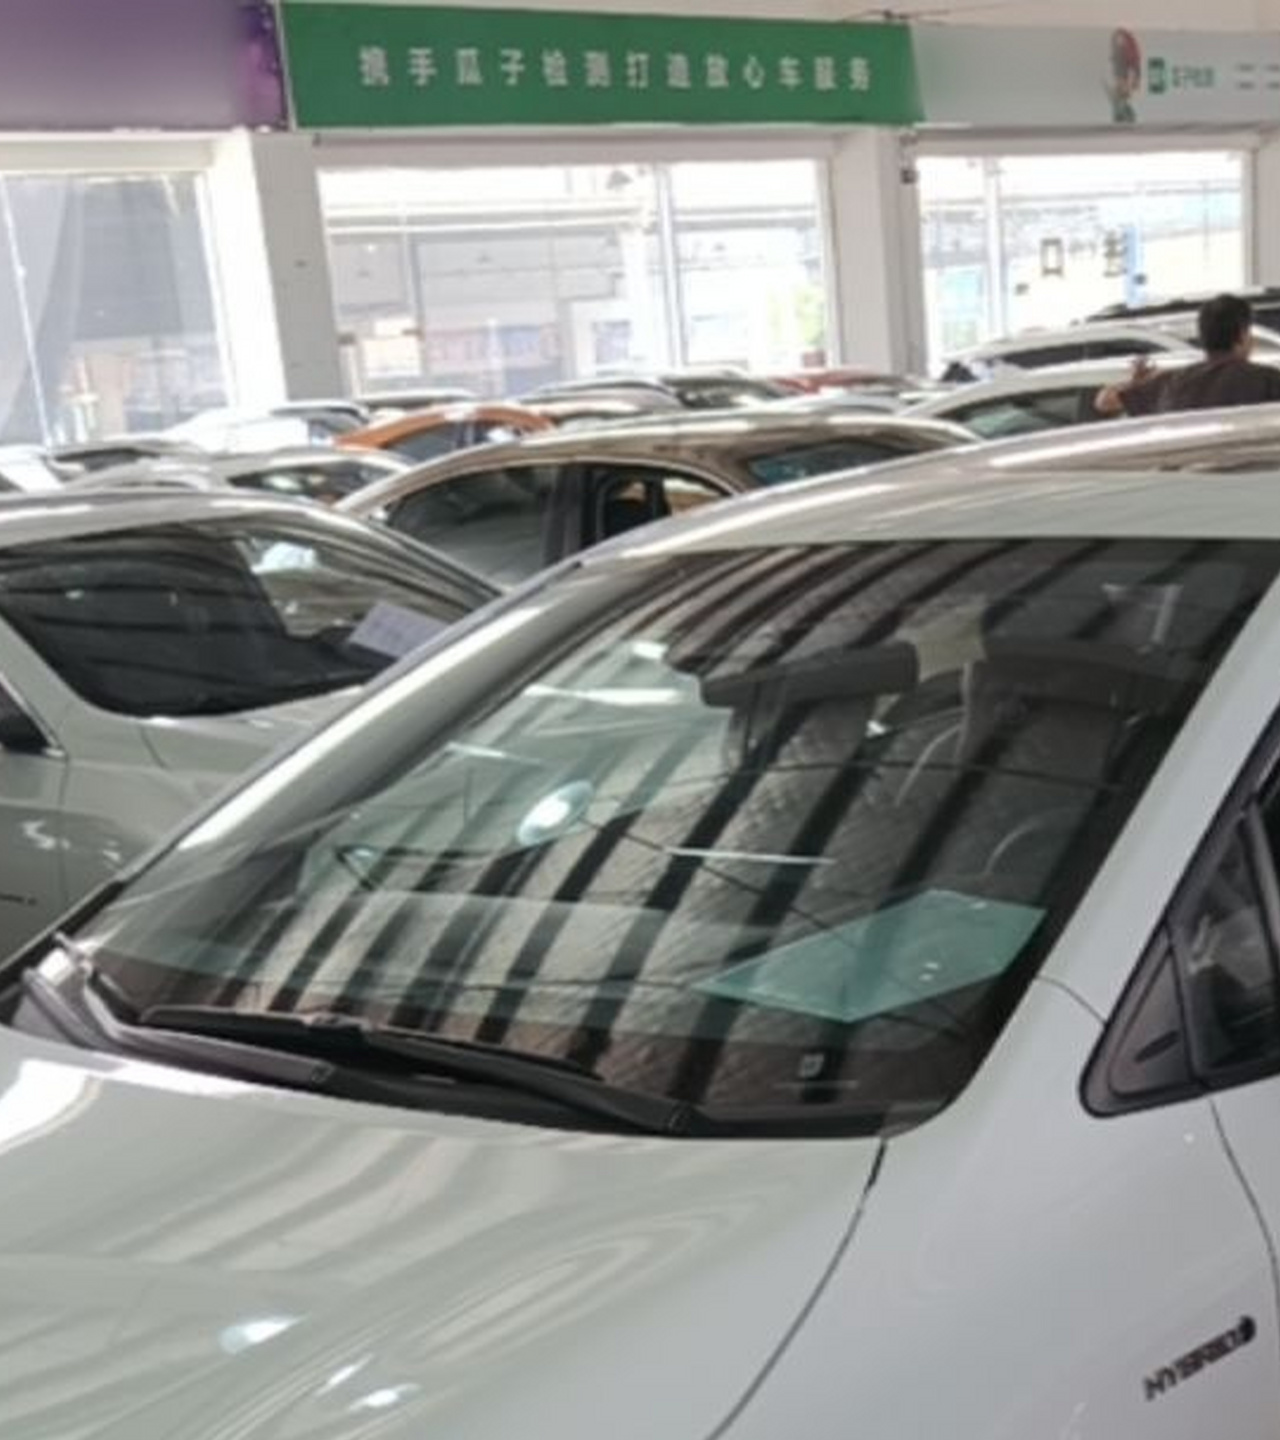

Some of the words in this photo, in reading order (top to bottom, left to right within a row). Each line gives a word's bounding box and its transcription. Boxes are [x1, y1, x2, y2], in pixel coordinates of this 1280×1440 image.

[359, 46, 871, 91] 携手瓜子检测打造放心车服务
[1142, 1328, 1241, 1401] HYBRID
